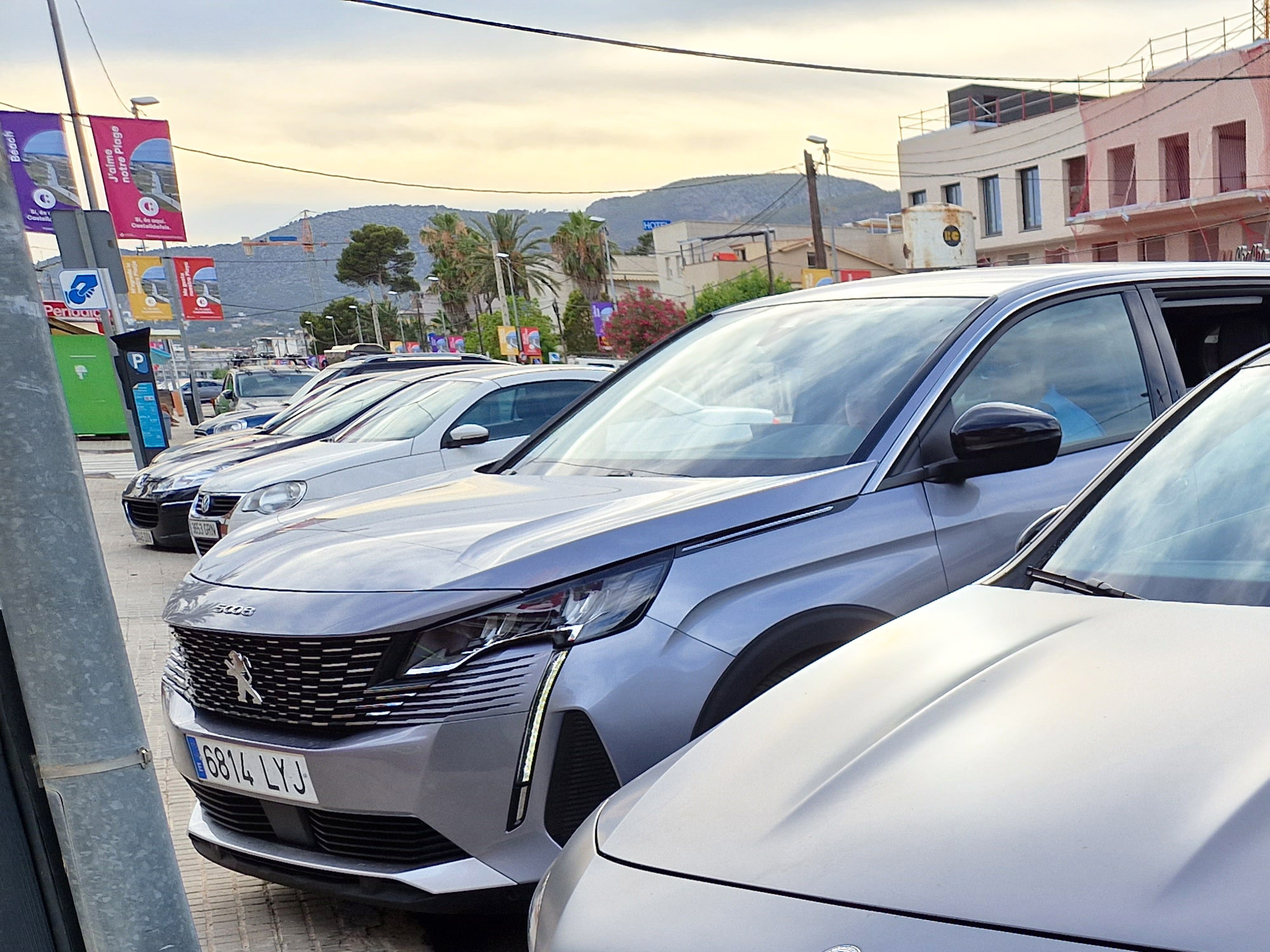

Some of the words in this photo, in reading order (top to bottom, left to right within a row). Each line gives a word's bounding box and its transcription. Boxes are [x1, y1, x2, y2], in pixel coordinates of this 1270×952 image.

[4, 130, 21, 162] Beach
[111, 125, 124, 154] Plage
[105, 149, 119, 182] J'aime
[118, 156, 131, 183] notre
[132, 353, 144, 369] P
[213, 603, 256, 617] 5008
[203, 744, 254, 786] 6814
[259, 754, 306, 795] LYJ
